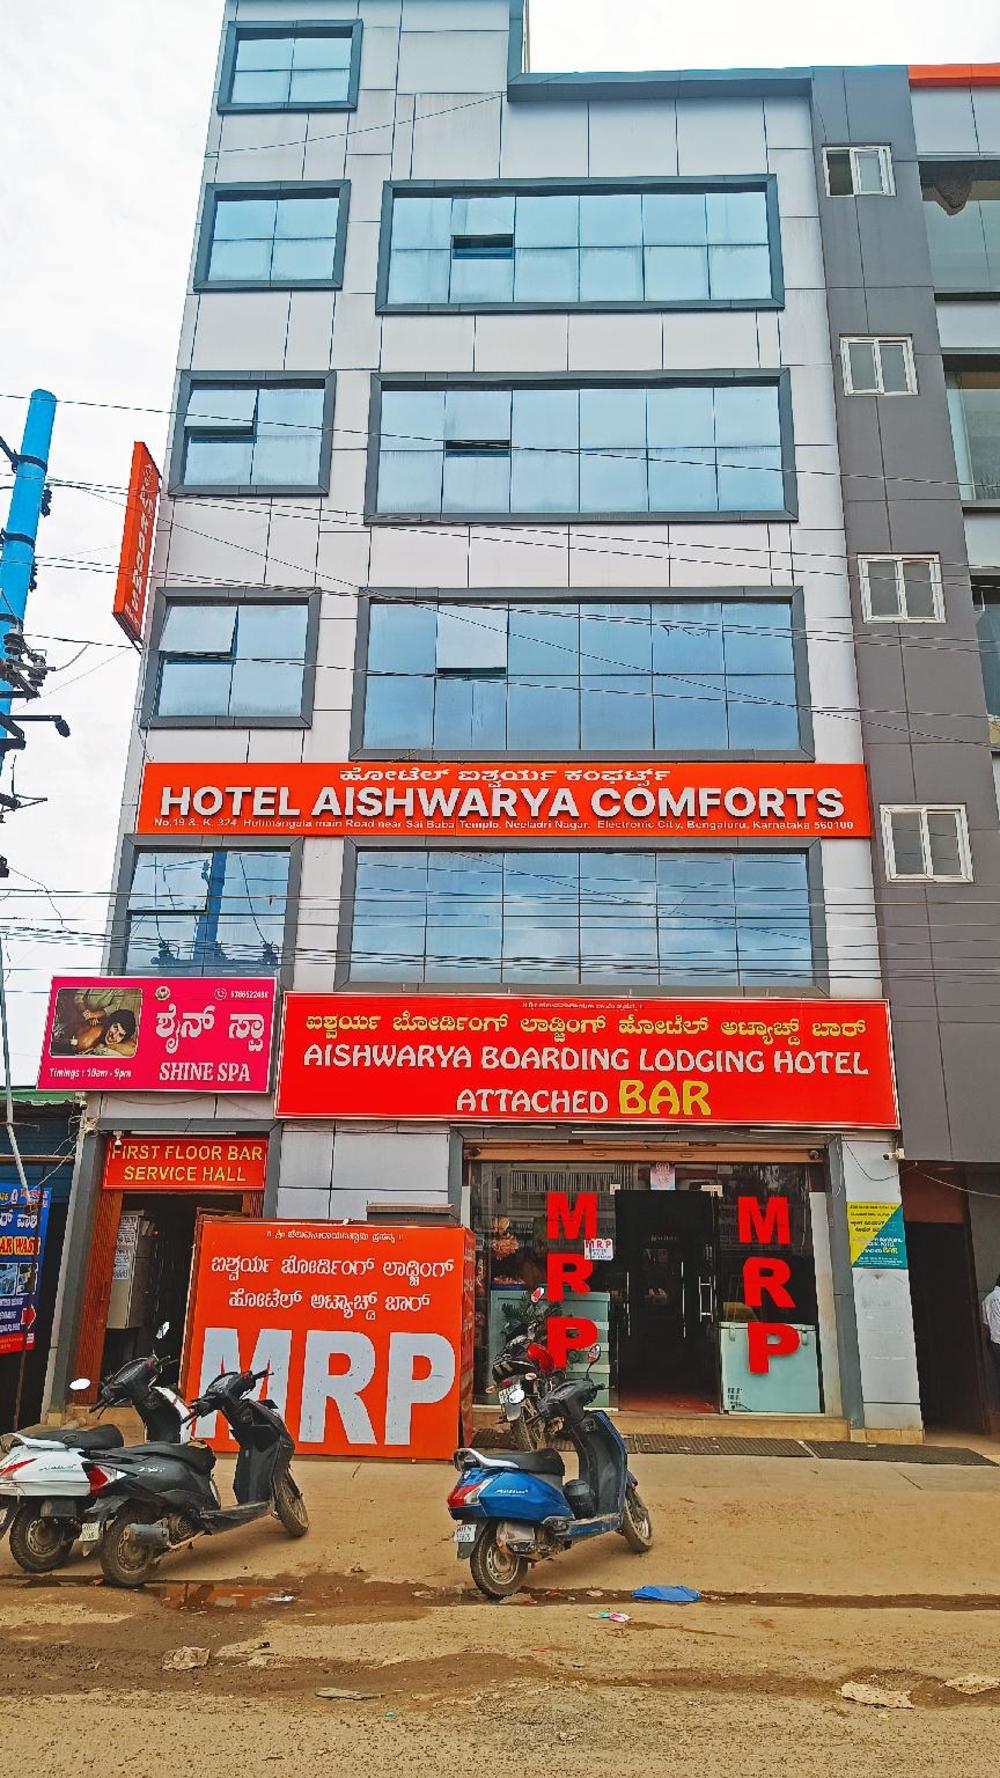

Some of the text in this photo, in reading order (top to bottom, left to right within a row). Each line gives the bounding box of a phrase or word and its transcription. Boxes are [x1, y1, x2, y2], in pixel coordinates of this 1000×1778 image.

[161, 785, 844, 817] HOTEL AISHWARYA COMFORTS
[344, 819, 376, 829] Road
[596, 820, 654, 830] Electronic
[752, 821, 812, 831] Karnataka
[156, 1004, 215, 1053] ಶೈನ್
[619, 1014, 708, 1034] ಹೋಟೆಲ್
[813, 1020, 865, 1036] ಬಾರ್
[160, 1063, 250, 1081] SHINE SPA
[304, 1044, 868, 1074] AISHWARYA BOARDING LODGING HOTEL
[114, 1067, 132, 1080] 9pm
[457, 1080, 711, 1115] ATTACHED BAR
[112, 1146, 263, 1161] FIRST FLOOR BAR
[124, 1166, 246, 1182] SERVICE HALL
[546, 1191, 599, 1370] MRP
[737, 1196, 800, 1374] MRP
[229, 1288, 302, 1308] ಹೋಟೆಲ್
[385, 1294, 430, 1311] ಬಾರ್
[194, 1327, 456, 1445] MRP
